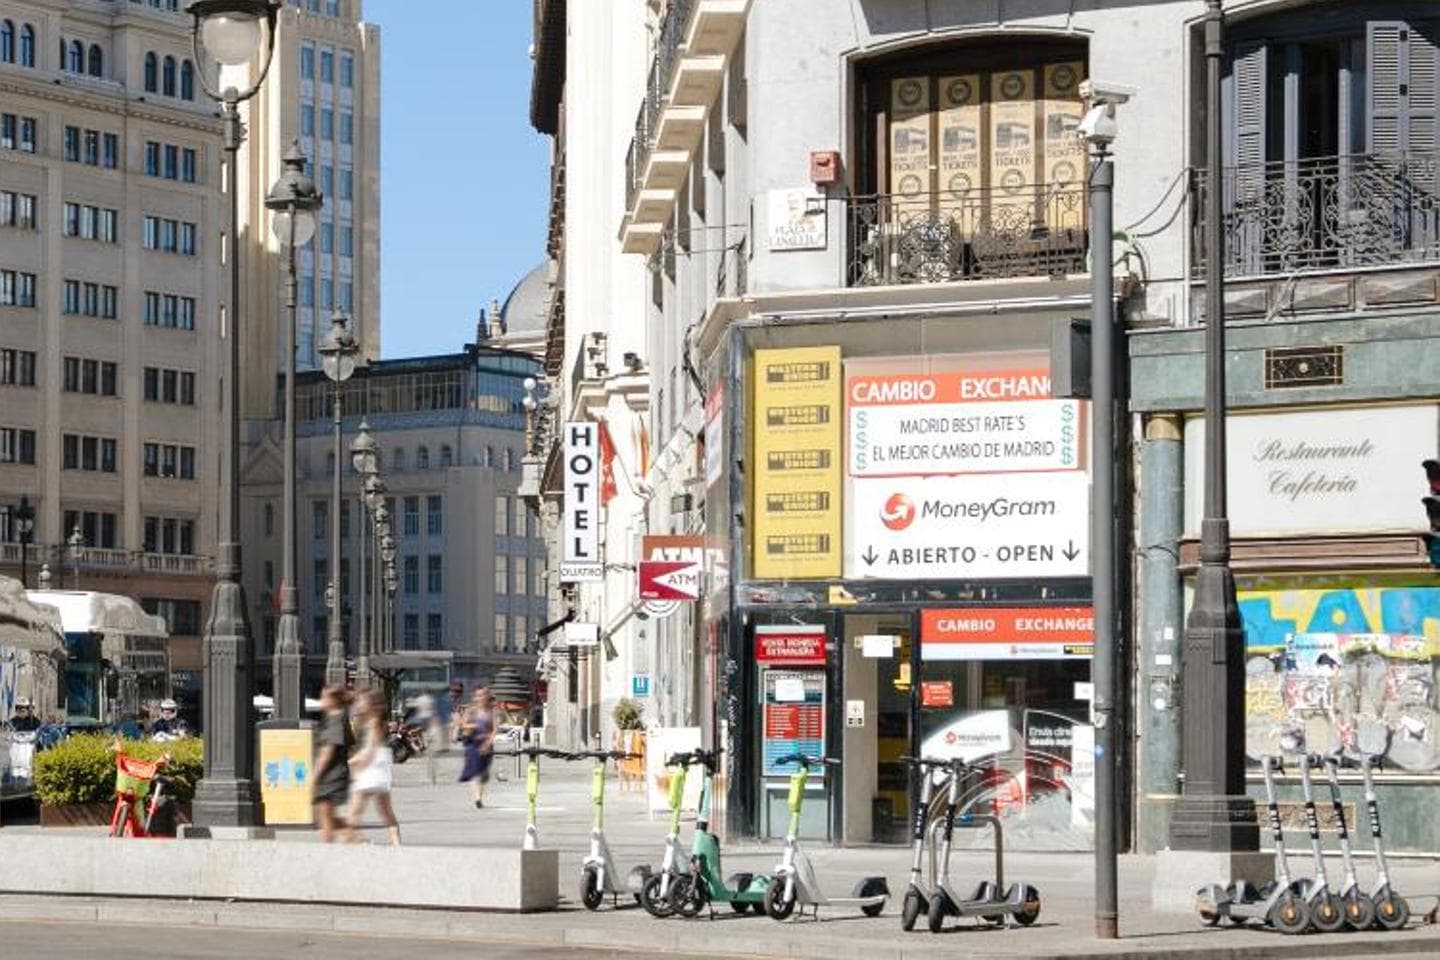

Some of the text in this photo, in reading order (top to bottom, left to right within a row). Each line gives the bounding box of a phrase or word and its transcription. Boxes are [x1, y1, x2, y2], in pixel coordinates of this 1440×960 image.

[852, 379, 936, 402] CAMBIO
[900, 417, 950, 434] MADRID
[952, 416, 981, 433] BEST
[873, 441, 1054, 461] EL MEJOR CAMBIO DE MADRID
[1254, 438, 1373, 461] Restaurante
[570, 426, 592, 557] HOTEL
[1266, 471, 1358, 501] Cafetería
[922, 498, 1055, 522] MoneyGram
[888, 546, 976, 564] ABIERTO
[997, 545, 1053, 562] OPEN
[668, 575, 696, 584] ATM
[937, 617, 1095, 632] CAMBIO EXCHANGE
